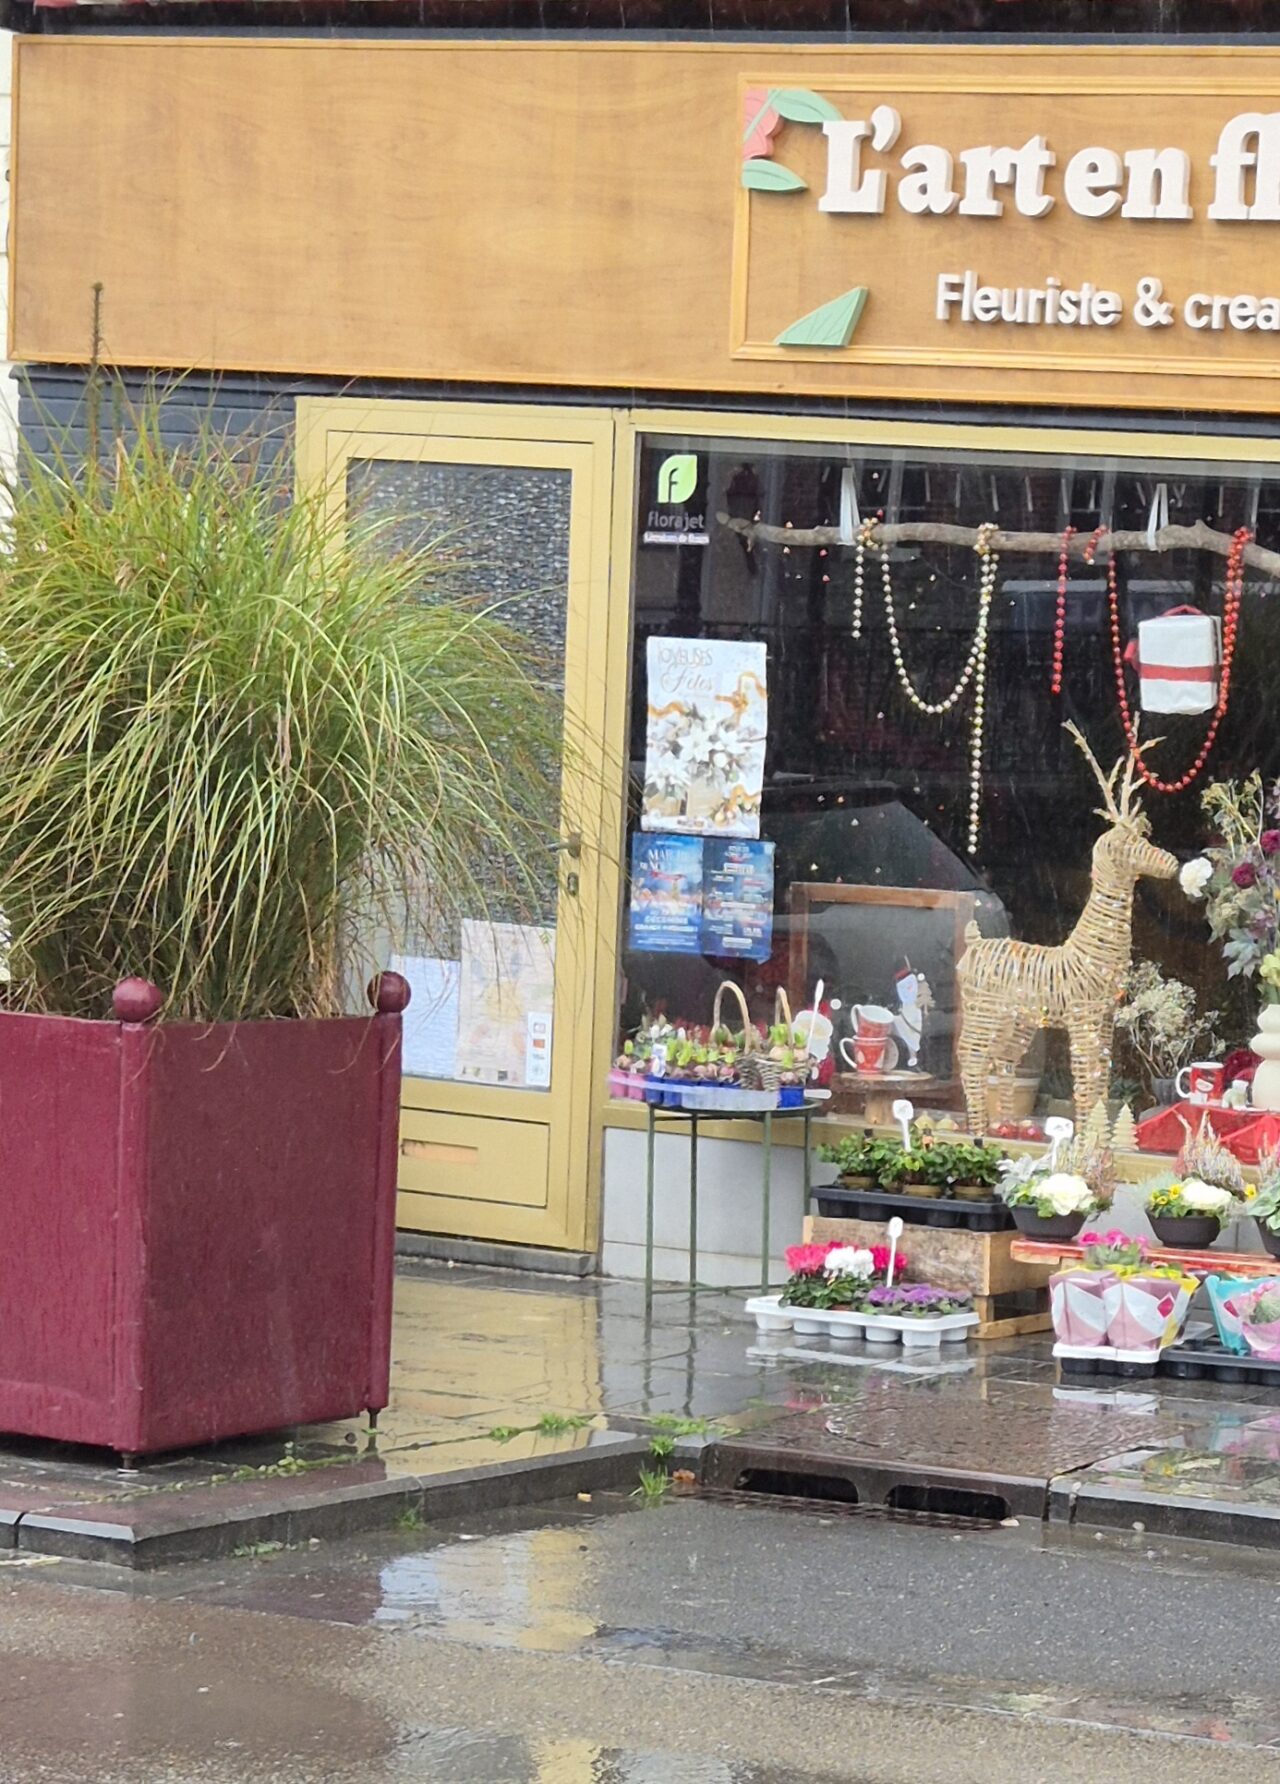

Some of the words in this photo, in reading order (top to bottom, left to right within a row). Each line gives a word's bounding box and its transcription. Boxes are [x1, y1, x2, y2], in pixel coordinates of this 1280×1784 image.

[1064, 147, 1194, 220] en
[936, 270, 1123, 327] Fleuriste
[1133, 276, 1175, 328] &
[648, 510, 705, 532] florajet
